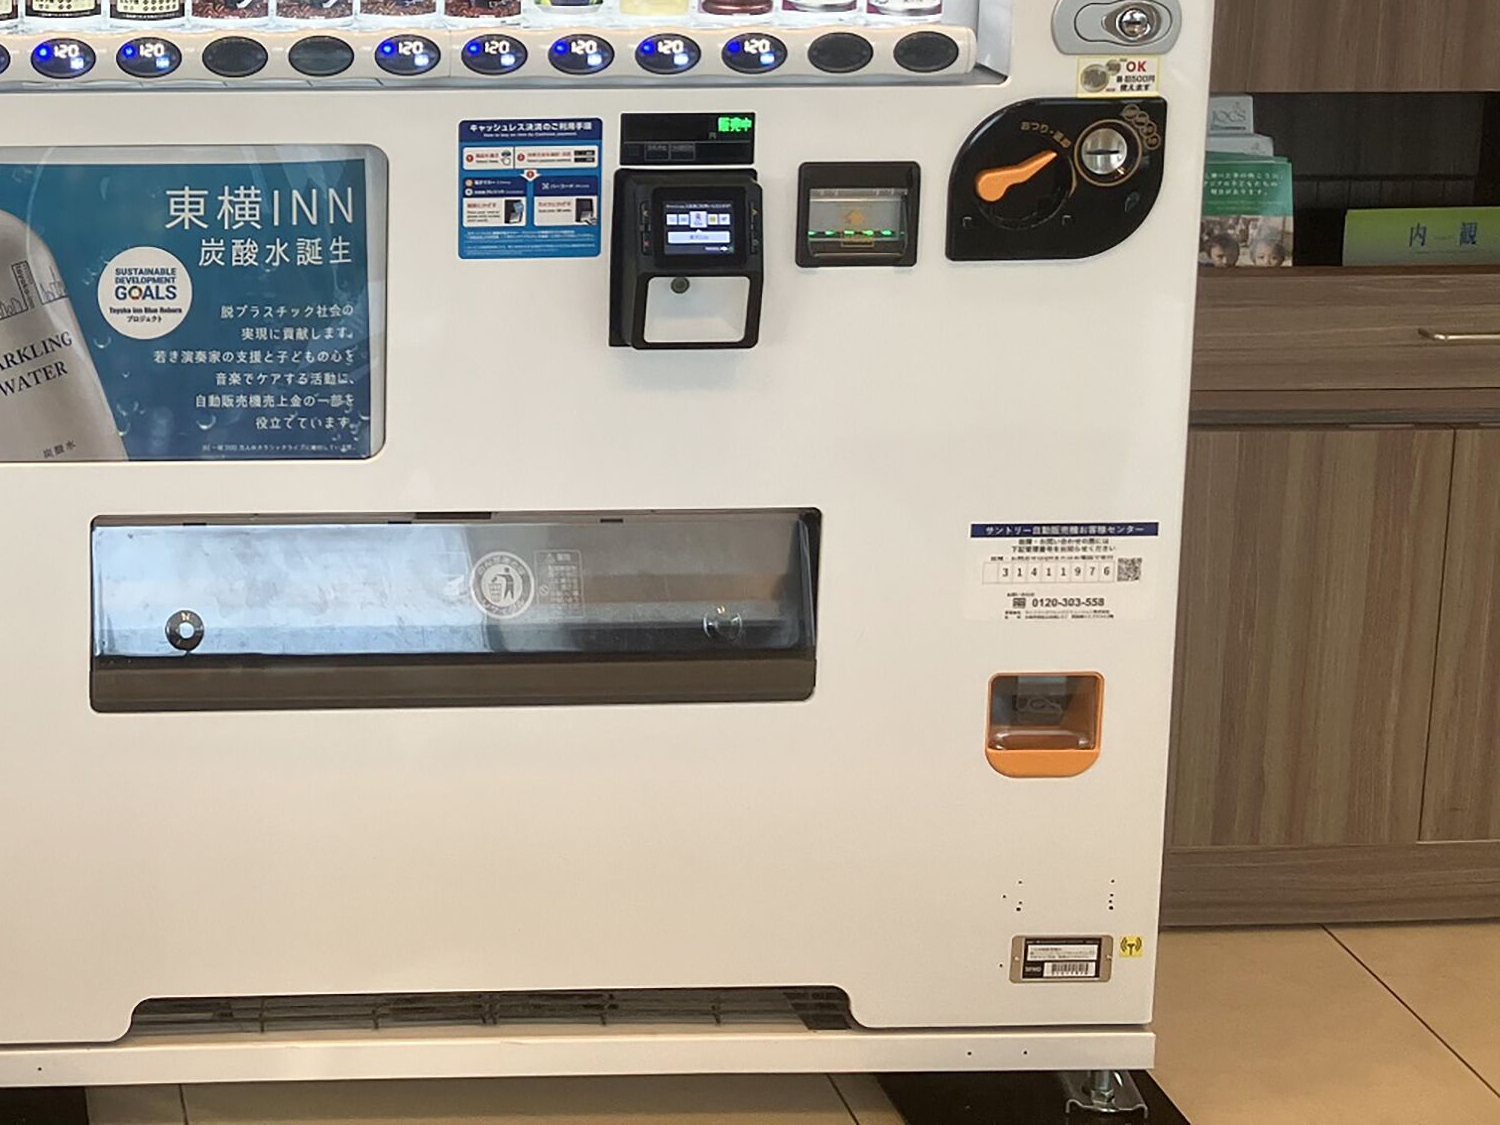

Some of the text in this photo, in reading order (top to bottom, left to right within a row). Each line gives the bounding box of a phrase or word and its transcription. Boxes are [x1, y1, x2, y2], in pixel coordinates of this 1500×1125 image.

[1126, 61, 1147, 72] OK
[164, 185, 354, 230] 東横INN
[197, 236, 353, 267] 炭酸水誕生
[115, 267, 177, 276] SUSTAINABLE
[115, 276, 177, 284] DEVELOPMENT
[114, 285, 178, 301] GOALS
[220, 304, 354, 320] 脱プラスチック社会の
[241, 328, 354, 341] 実現に貢献します。
[152, 349, 355, 364] 若き演奏家の支援と子どもの心を
[214, 372, 355, 386] 音楽でケアする活動に、
[195, 394, 355, 408] 自動販売機売上金の一部を
[1031, 597, 1106, 608] 0120-303-558
